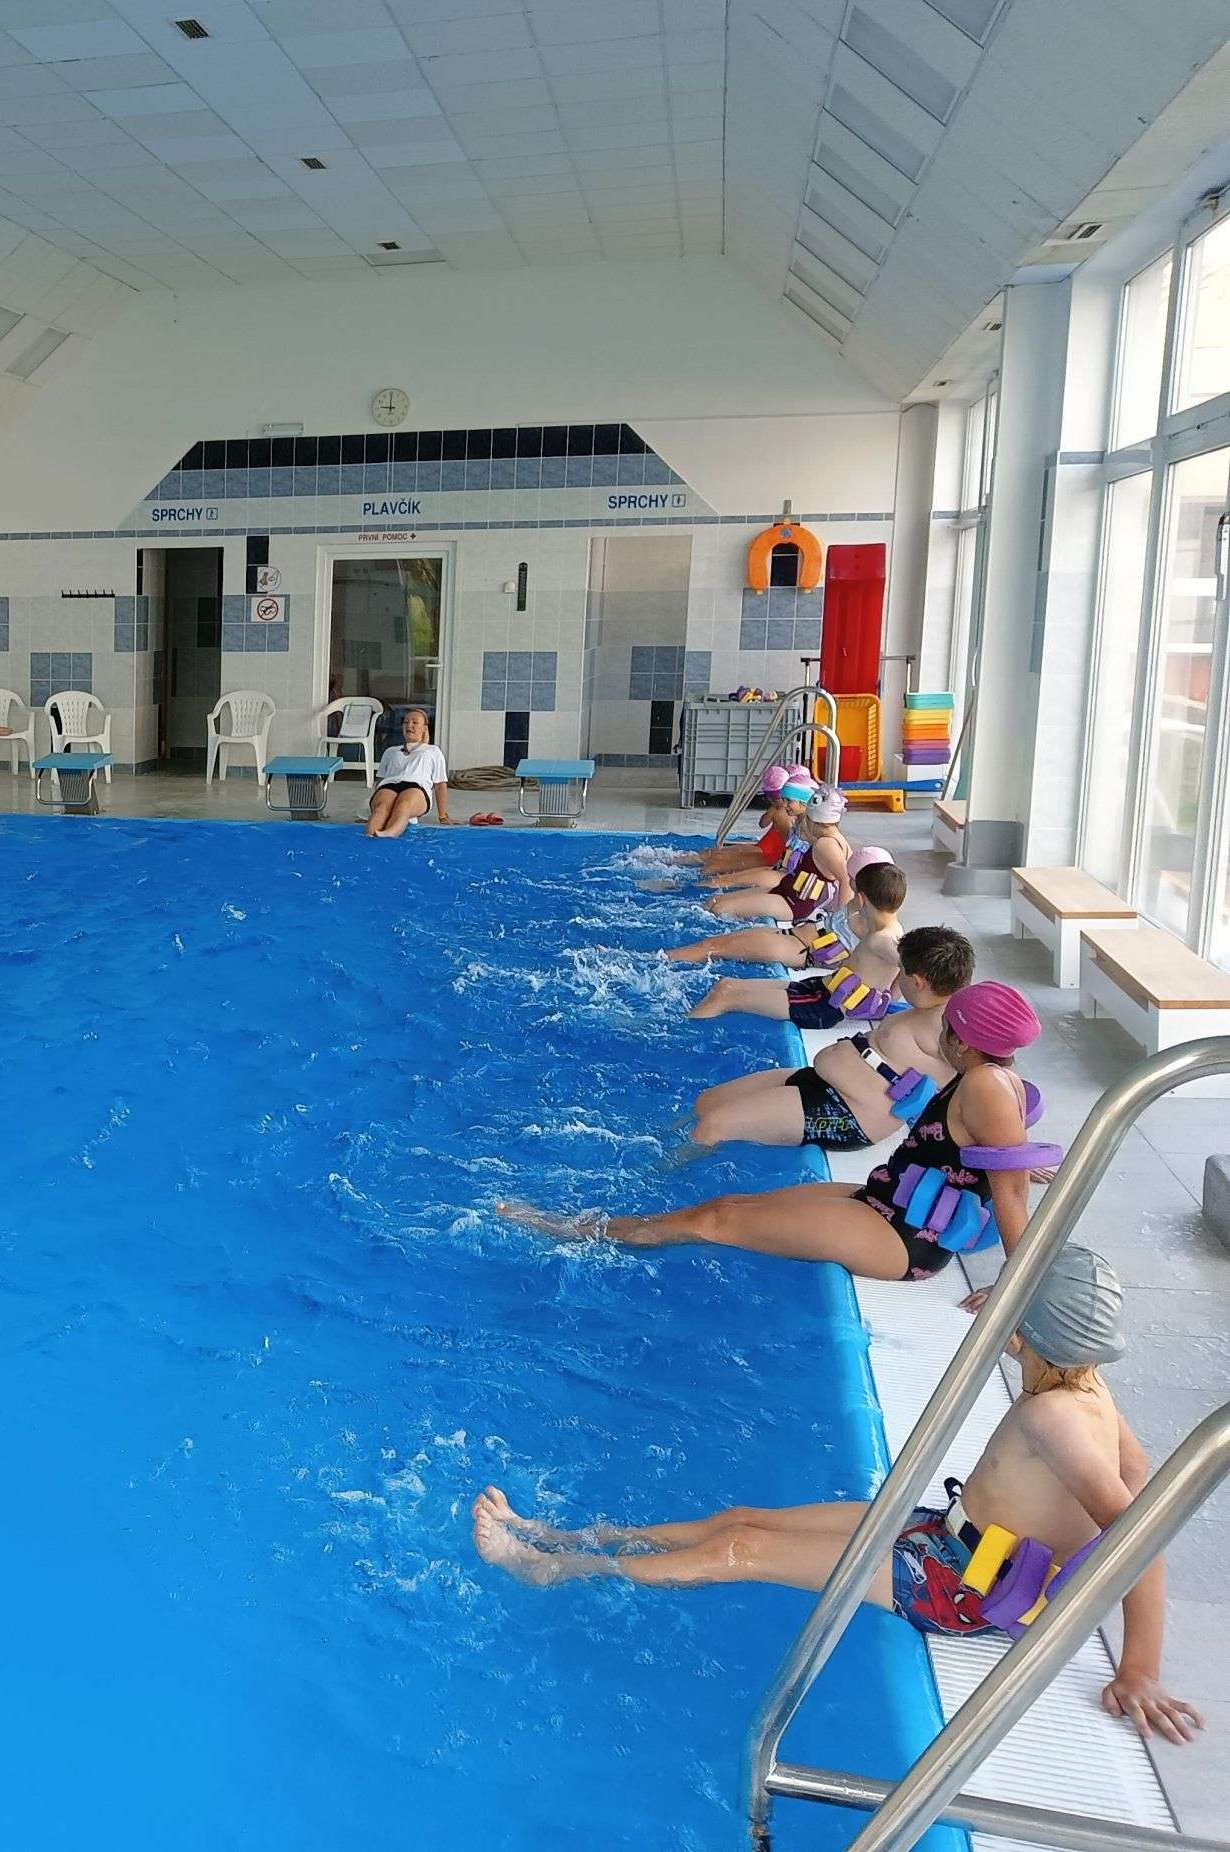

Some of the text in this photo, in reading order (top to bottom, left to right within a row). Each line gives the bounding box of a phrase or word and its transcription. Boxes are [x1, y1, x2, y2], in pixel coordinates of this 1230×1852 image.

[363, 497, 421, 516] PLAVČÍK
[608, 494, 668, 509] SPRCHY
[152, 508, 203, 521] SPRCHY
[382, 532, 408, 541] POMOC
